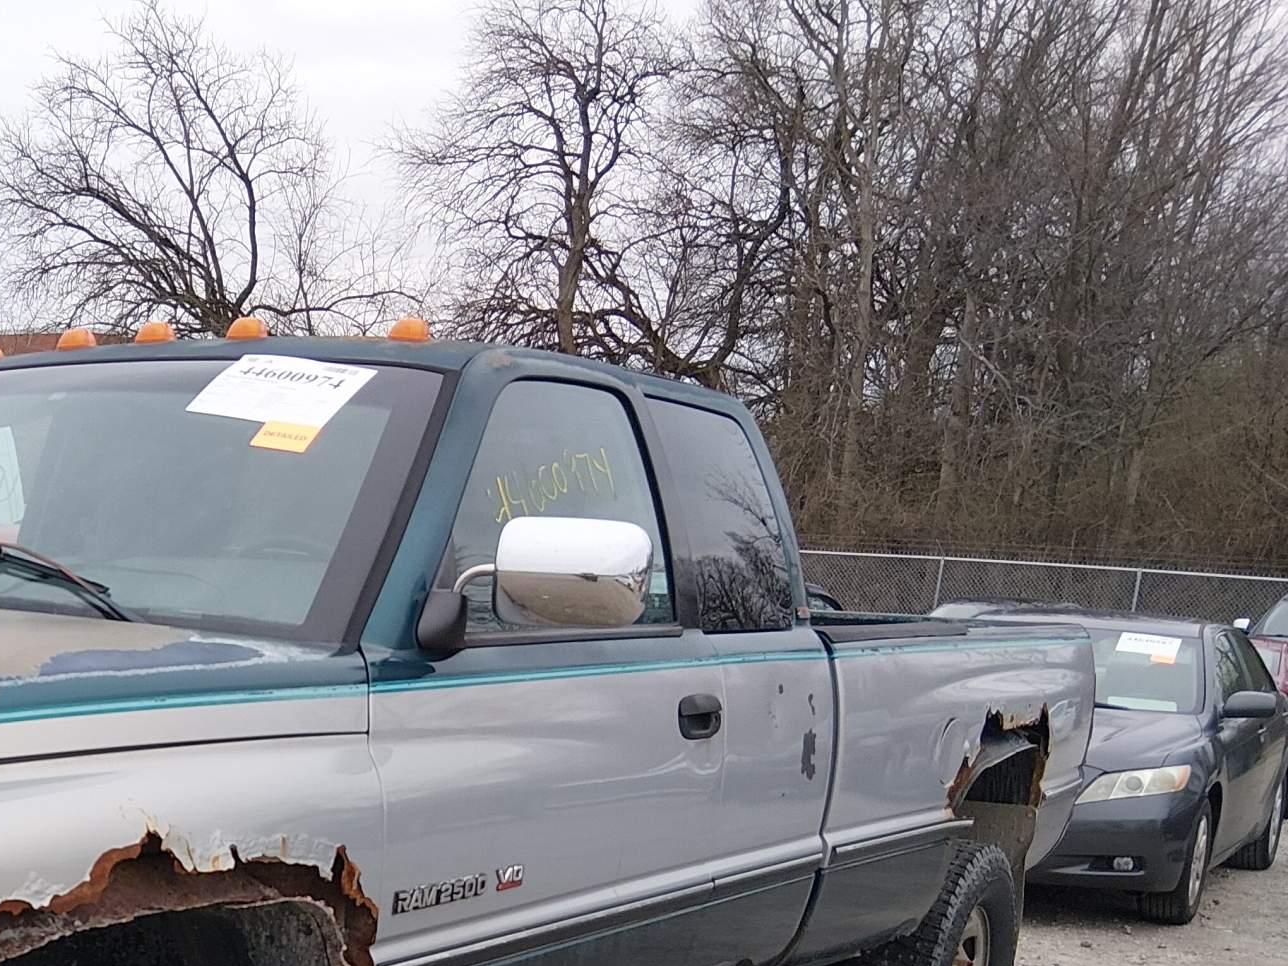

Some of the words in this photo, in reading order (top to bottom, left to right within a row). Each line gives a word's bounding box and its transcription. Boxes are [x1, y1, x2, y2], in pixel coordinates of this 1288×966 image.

[239, 365, 346, 391] 44600974
[392, 883, 440, 915] RAM
[438, 873, 488, 903] 2500
